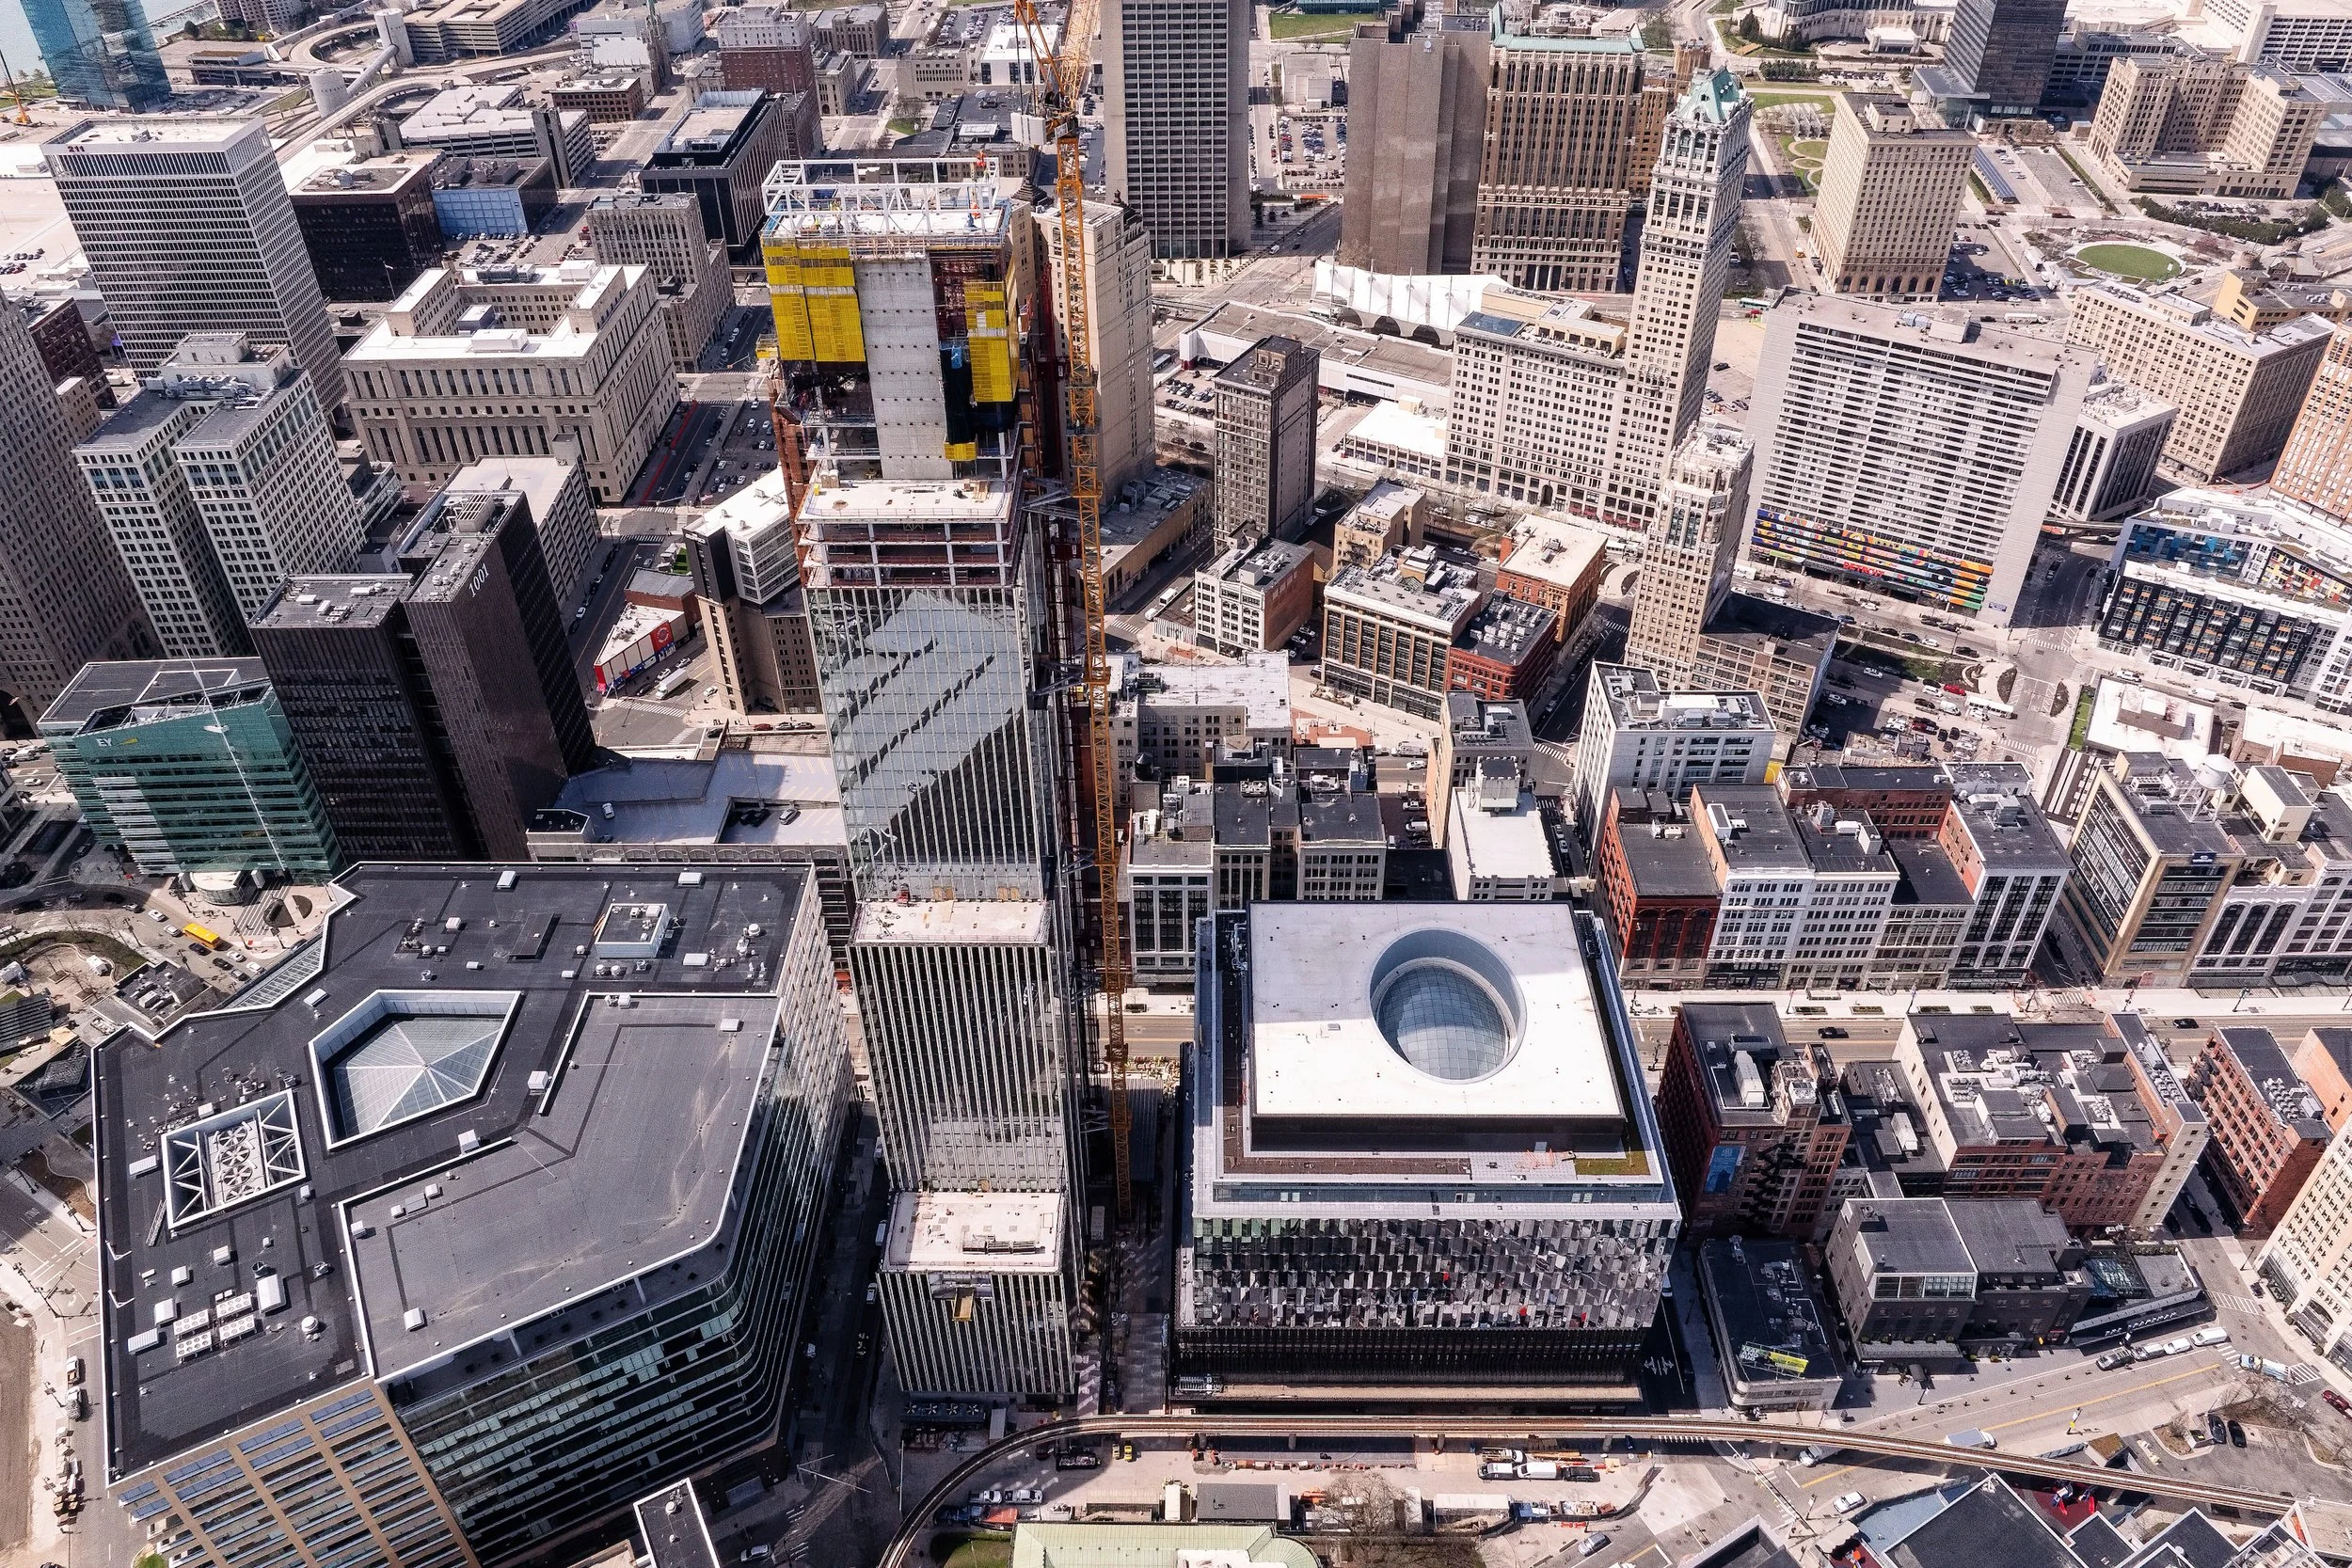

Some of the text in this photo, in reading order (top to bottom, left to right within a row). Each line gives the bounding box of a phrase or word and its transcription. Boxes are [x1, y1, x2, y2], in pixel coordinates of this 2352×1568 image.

[1843, 562, 1885, 578] DETROIT
[469, 562, 489, 597] 1001
[96, 737, 113, 746] EY
[1741, 1350, 1759, 1358] AND
